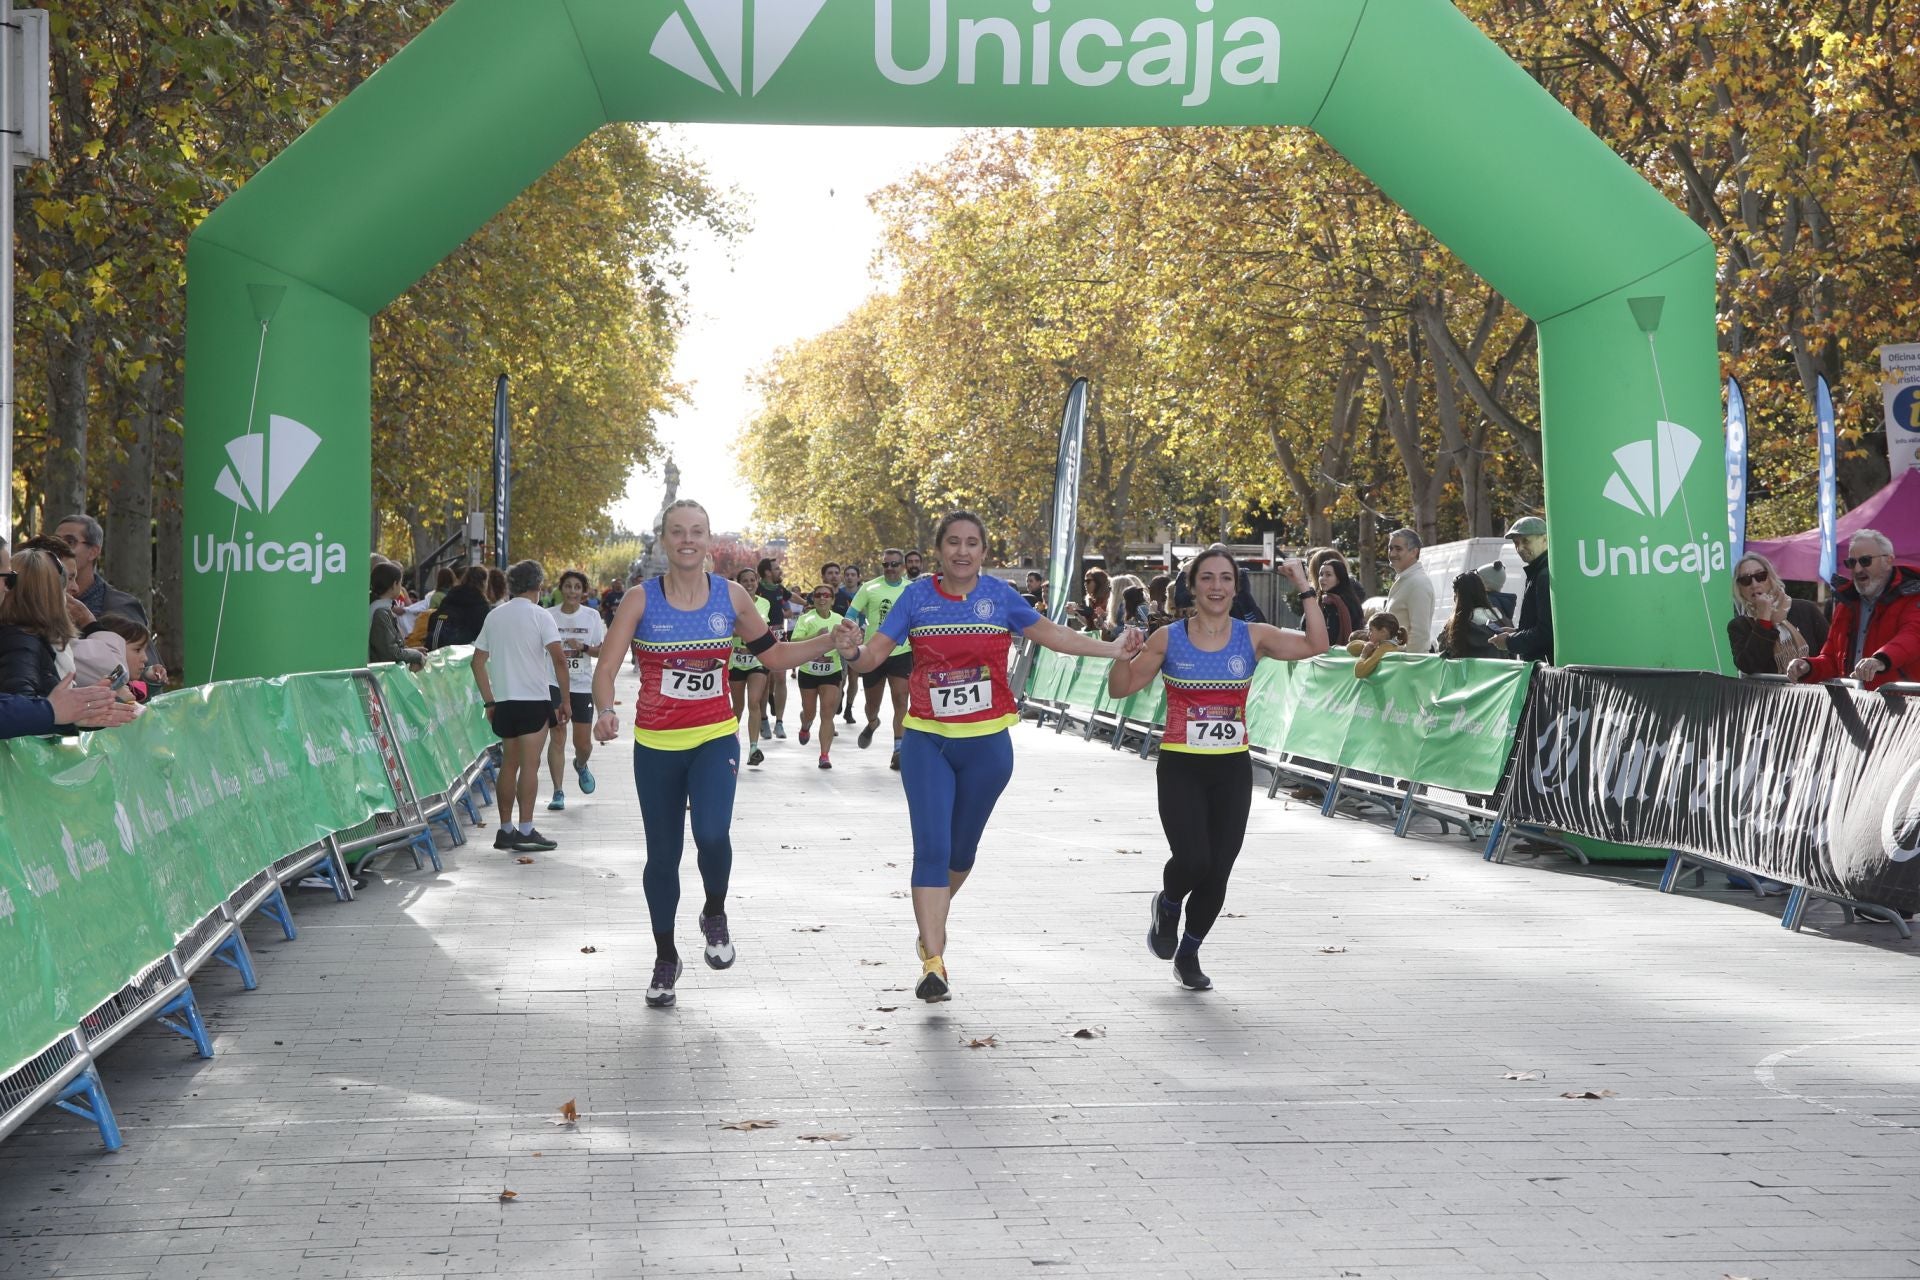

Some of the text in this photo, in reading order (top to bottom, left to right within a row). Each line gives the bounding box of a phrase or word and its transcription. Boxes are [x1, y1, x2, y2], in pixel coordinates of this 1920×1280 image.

[874, 0, 1281, 107] Unicaja
[193, 531, 347, 585] Unicaja
[1578, 532, 1725, 584] Unicaja
[735, 654, 755, 664] 617
[811, 663, 831, 672] 618
[672, 671, 715, 692] 750
[938, 684, 981, 708] 751
[1195, 722, 1237, 740] 749
